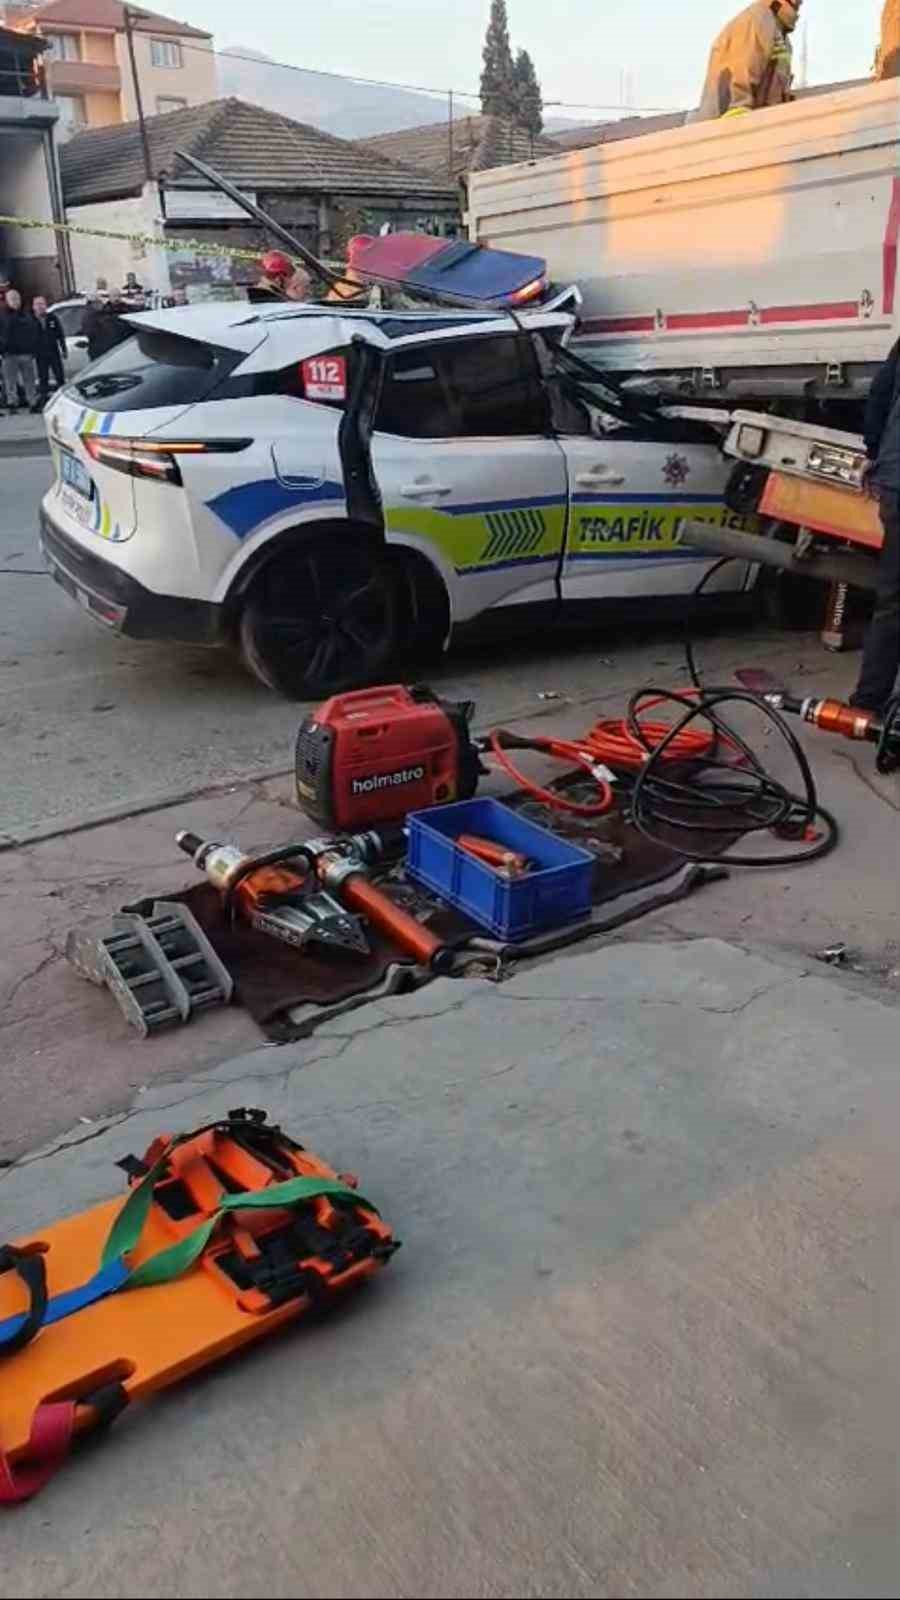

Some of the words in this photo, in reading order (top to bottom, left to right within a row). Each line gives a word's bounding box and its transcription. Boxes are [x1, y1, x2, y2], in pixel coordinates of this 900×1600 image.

[308, 360, 341, 383] 112
[578, 510, 665, 542] TRAFİK
[352, 767, 425, 793] holmatro
